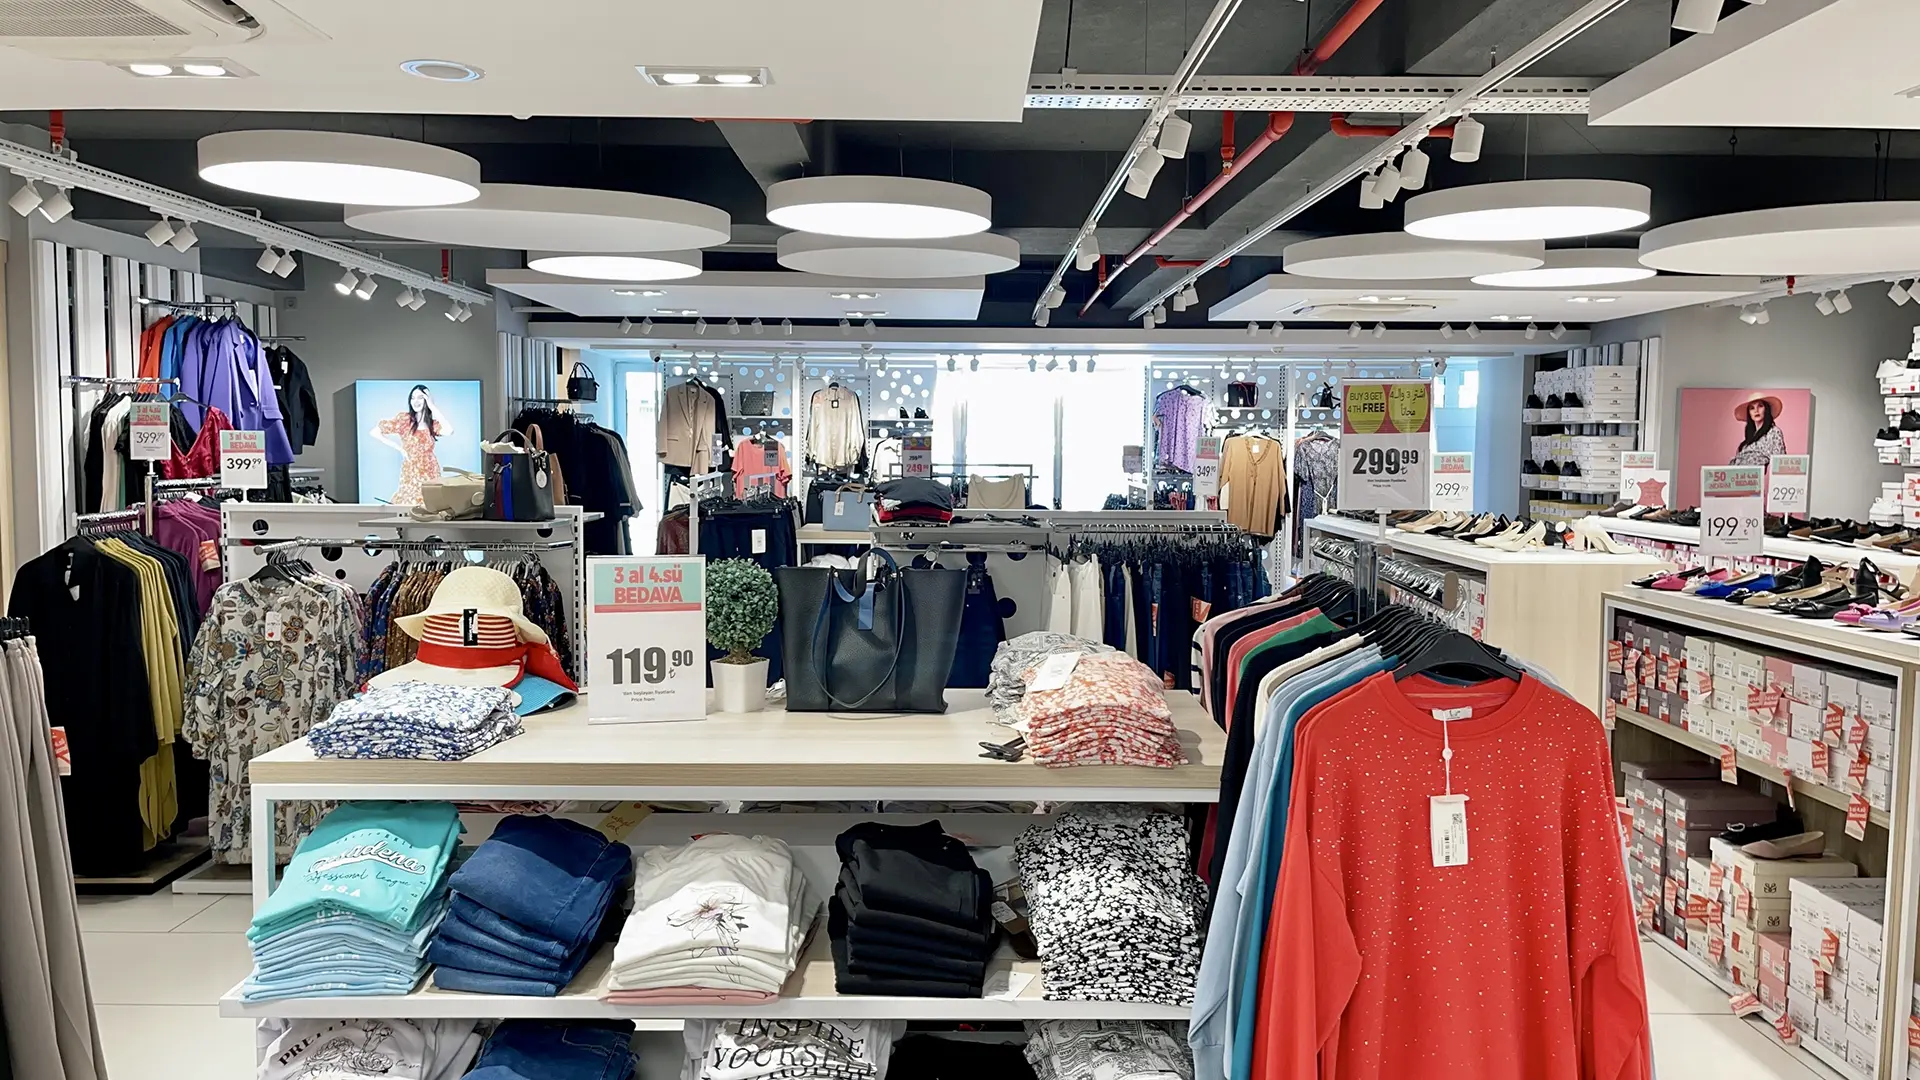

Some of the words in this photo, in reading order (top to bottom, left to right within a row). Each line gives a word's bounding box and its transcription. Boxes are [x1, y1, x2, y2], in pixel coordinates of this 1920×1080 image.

[1350, 392, 1364, 401] BUY
[1364, 392, 1369, 400] 3
[1370, 392, 1383, 400] GET
[1362, 402, 1385, 413] FREE
[136, 431, 157, 444] 399
[226, 457, 252, 470] 399
[1352, 448, 1401, 475] 299
[1401, 449, 1419, 464] 99
[1197, 465, 1211, 477] 349
[1435, 482, 1460, 496] 299
[1773, 487, 1796, 500] 299
[1708, 517, 1739, 537] 199
[1745, 518, 1759, 528] 90
[613, 566, 625, 584] 3
[628, 566, 644, 584] al
[614, 586, 684, 604] BEDAVA
[606, 647, 667, 685] 119
[671, 649, 694, 667] 90
[734, 1019, 864, 1059] INSPIRE
